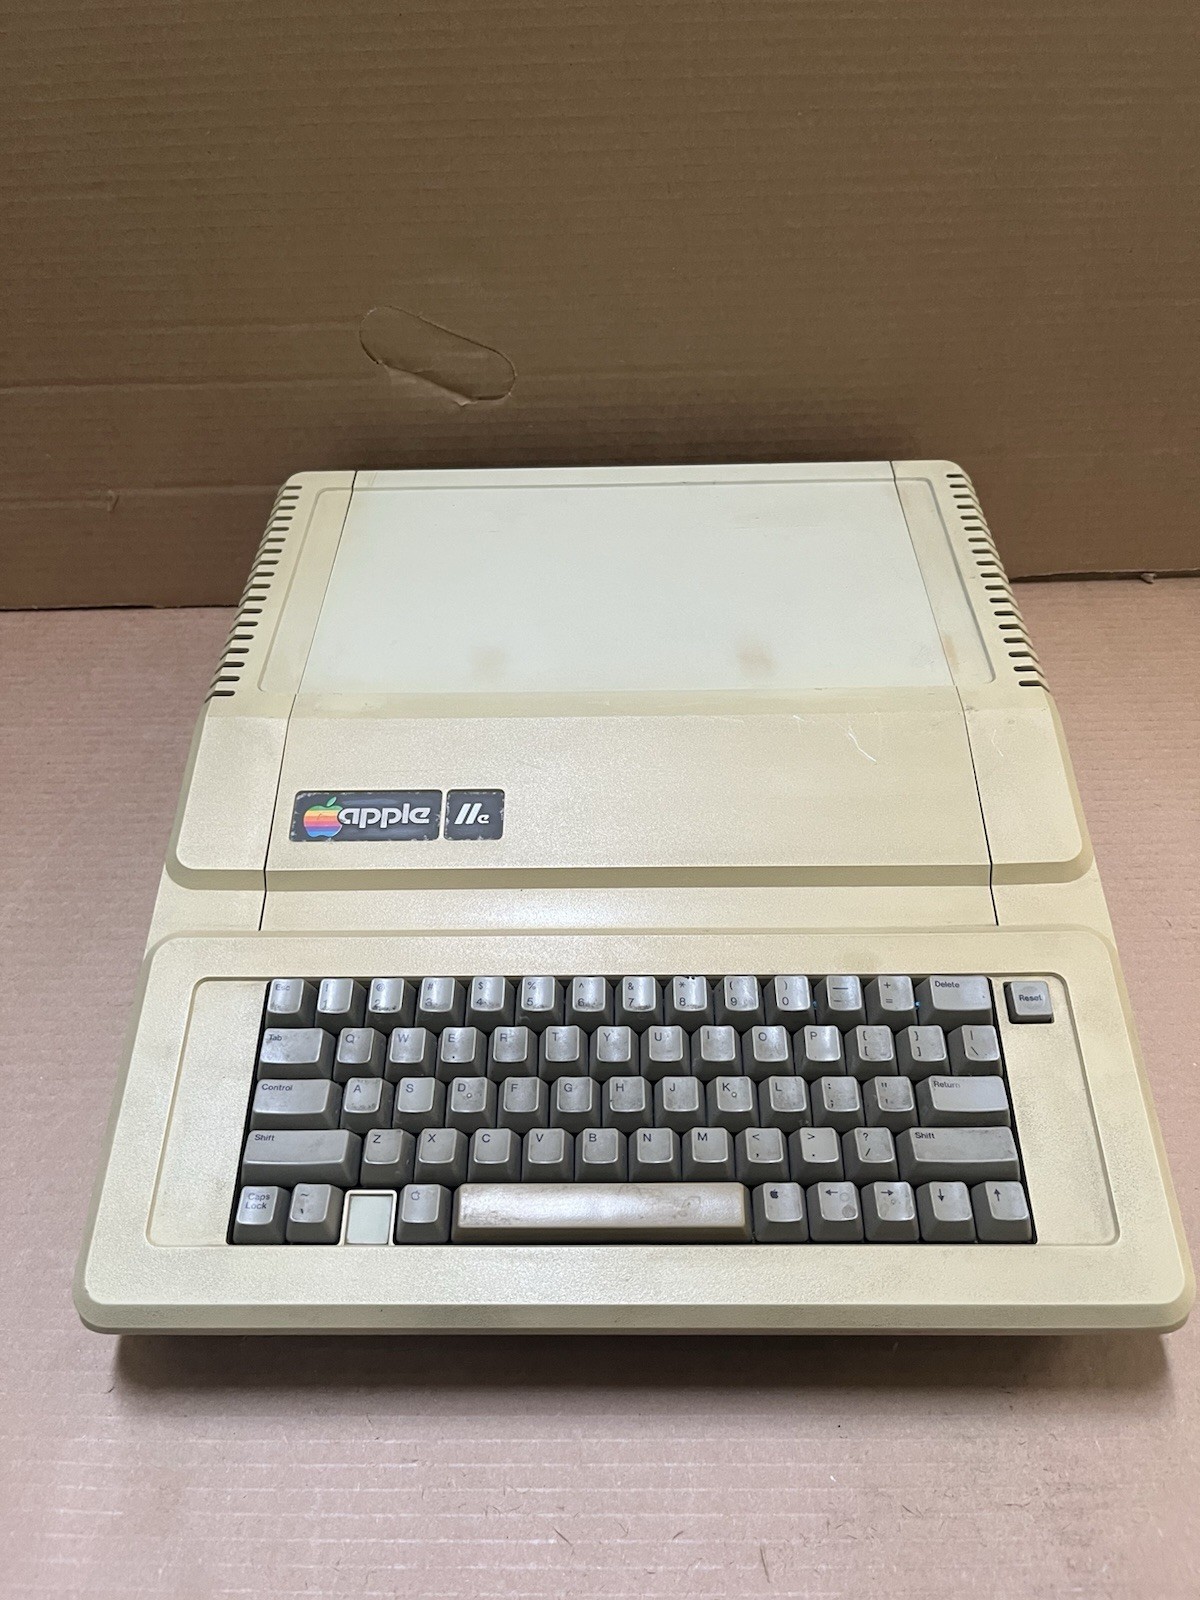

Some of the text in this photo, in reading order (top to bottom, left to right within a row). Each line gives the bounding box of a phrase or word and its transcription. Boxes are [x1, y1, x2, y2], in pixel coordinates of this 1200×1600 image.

[337, 803, 431, 829] apple
[478, 982, 483, 990] $
[527, 981, 536, 990] %
[935, 980, 960, 988] Delete
[527, 998, 534, 1006] 5
[578, 998, 585, 1007] 6
[628, 998, 635, 1007] 7
[680, 997, 686, 1007] 8
[730, 997, 737, 1006] 9
[1018, 994, 1043, 1002] Reset
[345, 1034, 355, 1043] Q
[398, 1034, 409, 1042] W
[448, 1034, 456, 1042] E
[500, 1033, 508, 1042] R
[552, 1032, 559, 1041] T
[603, 1033, 611, 1041] Y
[654, 1032, 662, 1041] U
[811, 1031, 817, 1040] P
[862, 1031, 867, 1041] {
[914, 1031, 919, 1041] }
[971, 1046, 979, 1056] \
[261, 1083, 293, 1091] Control
[353, 1084, 361, 1093] A
[405, 1083, 414, 1093] S
[457, 1083, 466, 1092] D
[511, 1083, 518, 1092] F
[563, 1083, 573, 1092] G
[616, 1083, 624, 1092] H
[669, 1083, 676, 1092] J
[722, 1083, 731, 1092] K
[775, 1082, 782, 1091] L
[933, 1080, 960, 1089] Return
[254, 1133, 275, 1141] Shift
[373, 1134, 382, 1143] Z
[427, 1133, 437, 1143] X
[482, 1133, 491, 1143] C
[536, 1133, 544, 1142] V
[589, 1133, 597, 1142] B
[643, 1133, 651, 1142] N
[697, 1132, 708, 1141] M
[863, 1132, 869, 1141] ?
[865, 1148, 871, 1156] /
[247, 1192, 271, 1202] Caps
[245, 1202, 267, 1210] Lock
